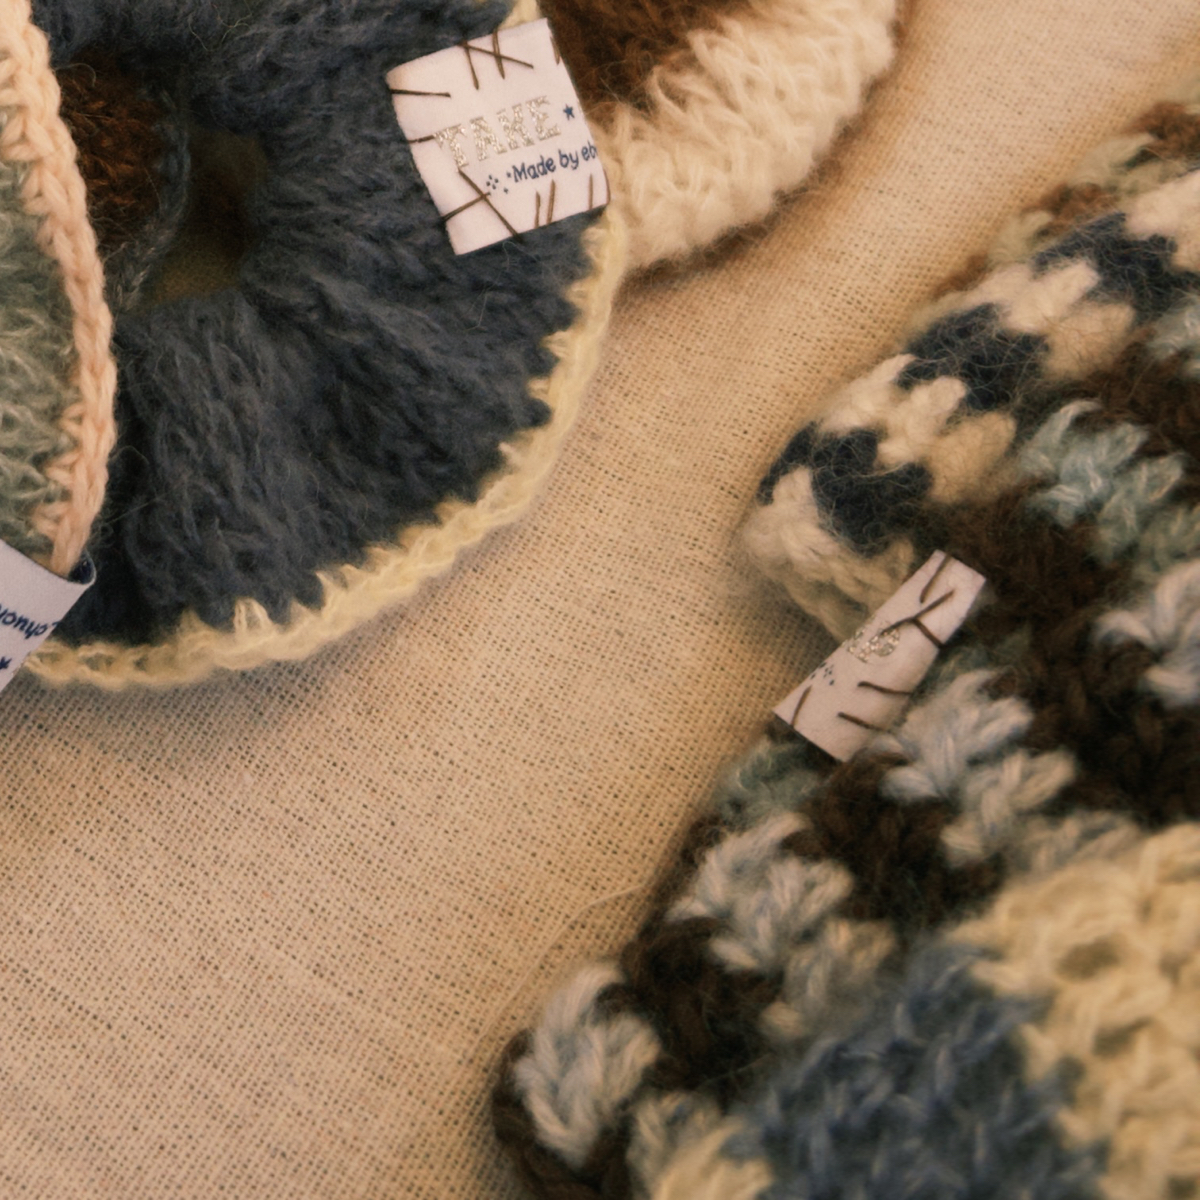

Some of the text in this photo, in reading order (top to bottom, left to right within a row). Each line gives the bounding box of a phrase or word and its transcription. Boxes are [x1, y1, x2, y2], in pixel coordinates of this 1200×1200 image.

[432, 95, 562, 168] TAKE
[511, 154, 556, 183] Made
[558, 147, 580, 171] by
